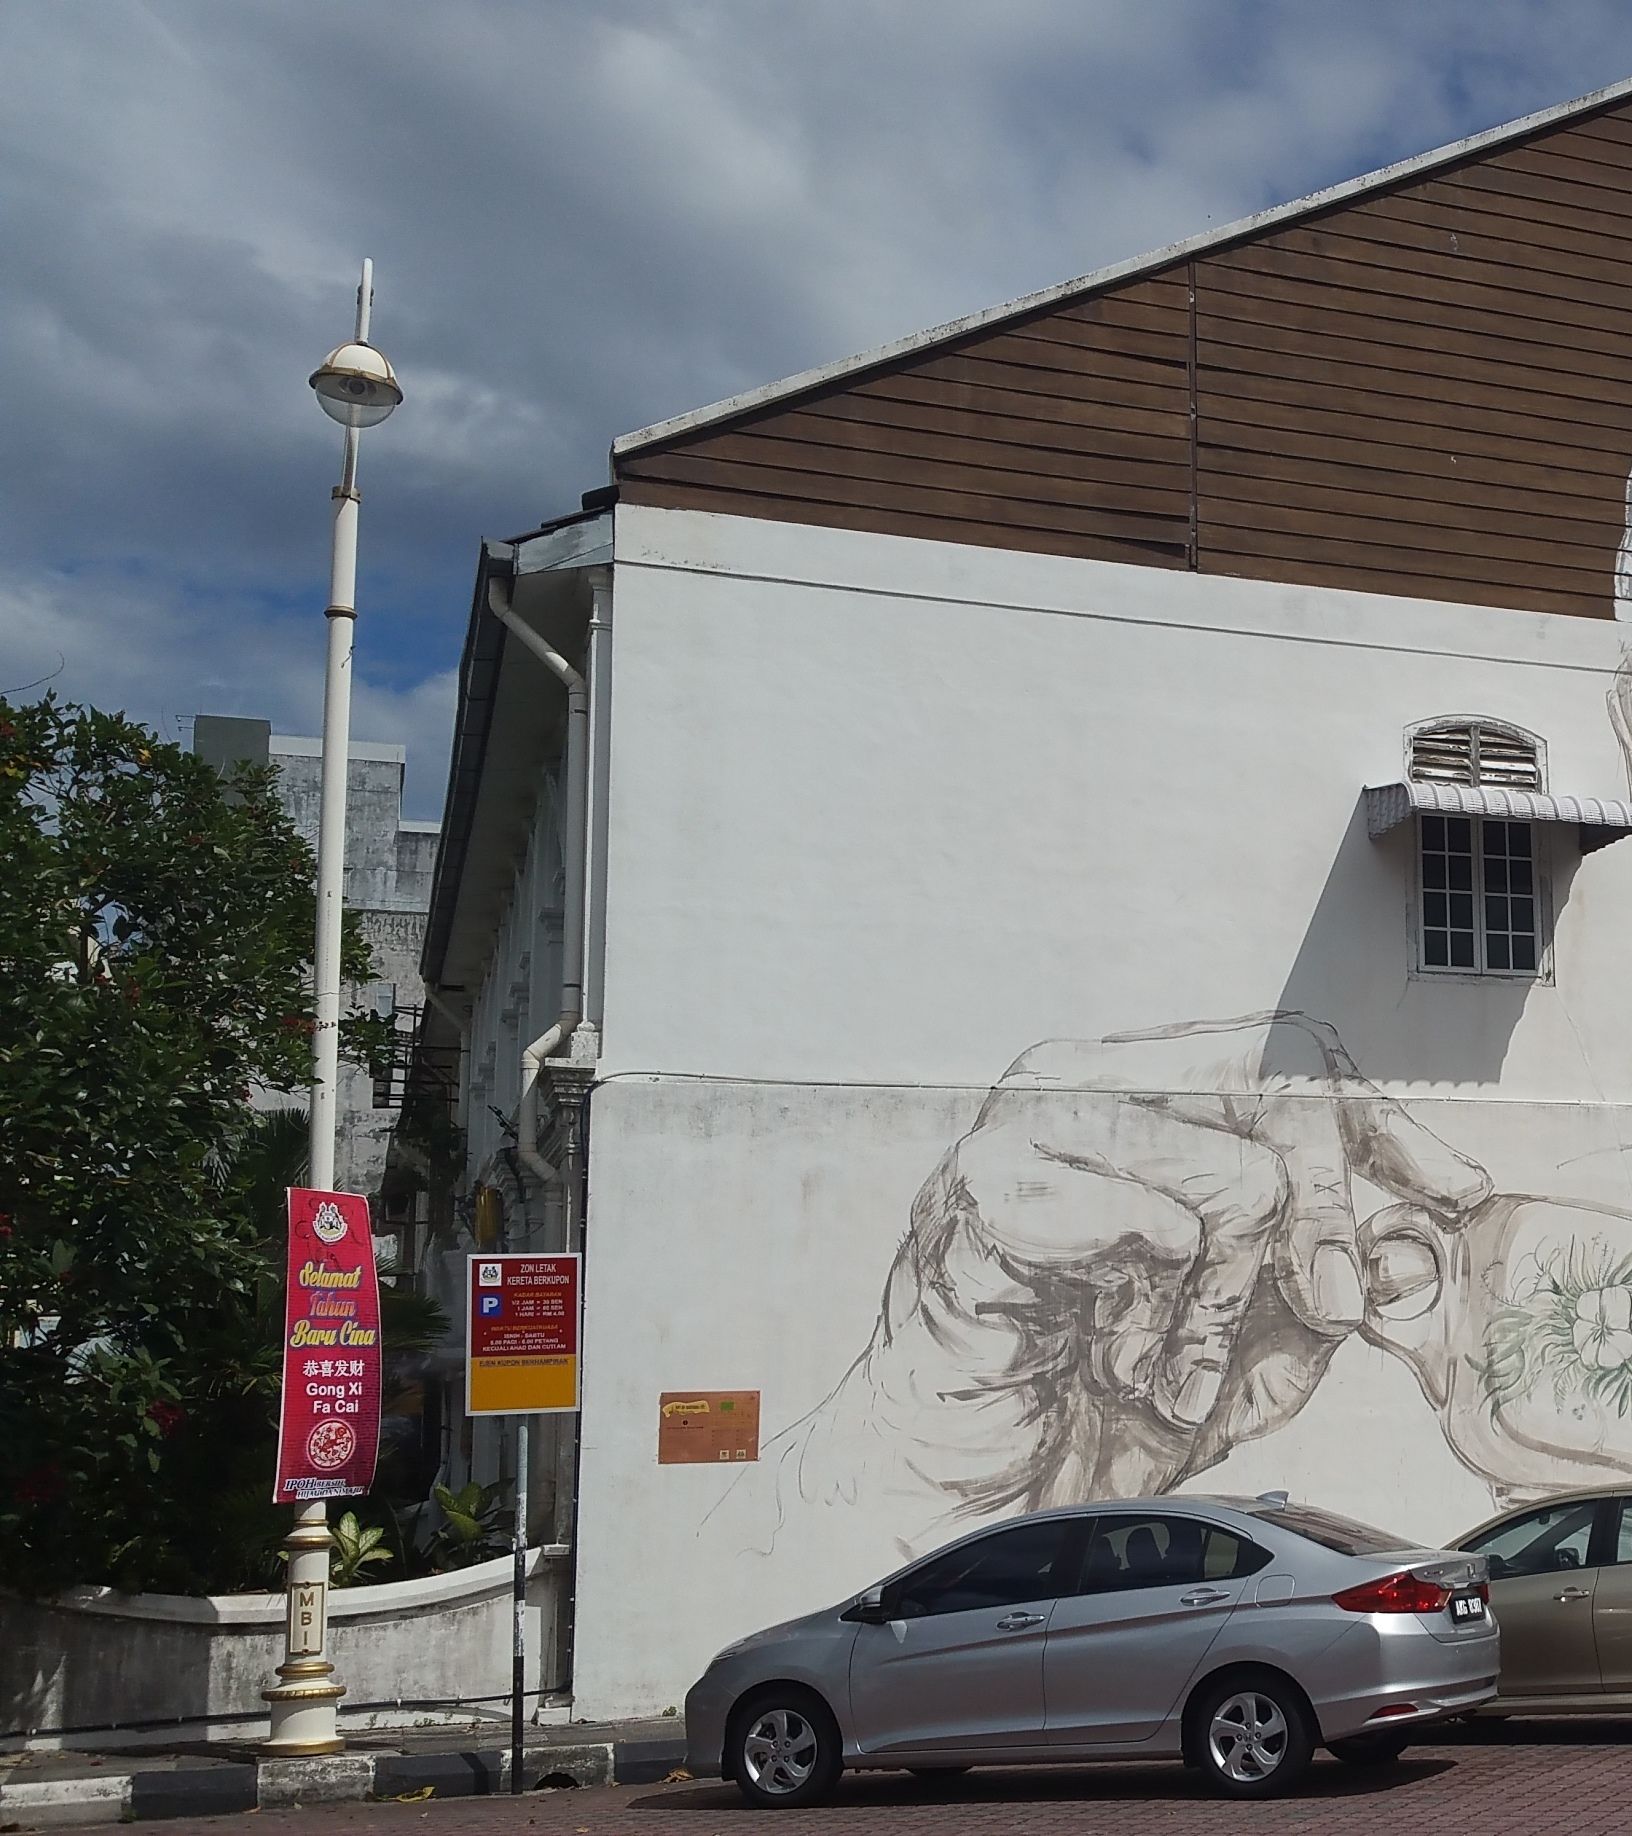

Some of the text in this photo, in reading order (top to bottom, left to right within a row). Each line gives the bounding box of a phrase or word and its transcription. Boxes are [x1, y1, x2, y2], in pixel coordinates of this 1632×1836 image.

[299, 1261, 362, 1288] Selamat
[520, 1263, 557, 1273] ZON LETAK
[507, 1275, 570, 1286] KERETA BERKUPON
[309, 1290, 356, 1316] Tahun
[482, 1297, 499, 1314] P
[289, 1319, 376, 1348] Baru Cina
[302, 1359, 365, 1378] 恭喜发财
[305, 1382, 363, 1399] Gong Xi
[313, 1399, 359, 1414] Fa Cai
[284, 1478, 316, 1490] IPOH
